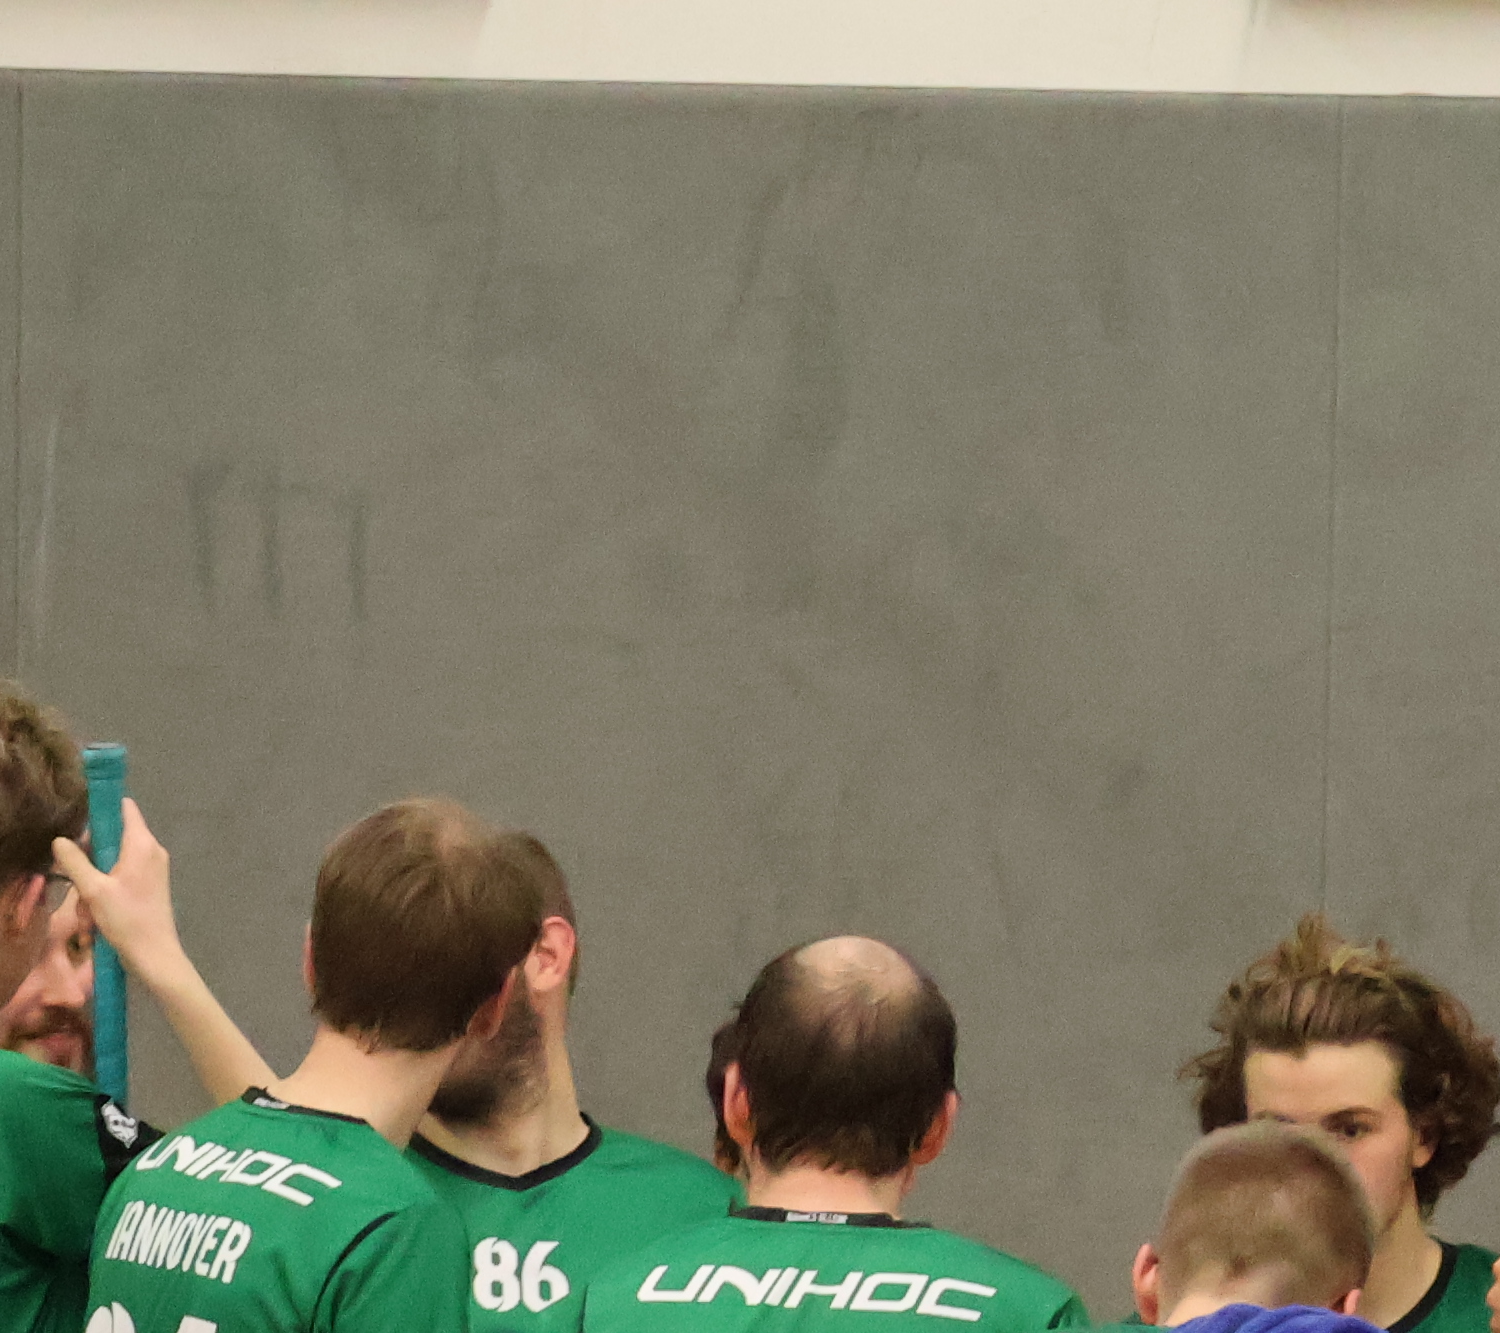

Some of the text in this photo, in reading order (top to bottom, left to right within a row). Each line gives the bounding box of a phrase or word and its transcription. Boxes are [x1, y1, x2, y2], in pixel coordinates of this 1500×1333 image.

[132, 1131, 344, 1208] UNIHOC
[471, 1235, 571, 1314] 86
[635, 1263, 998, 1323] UNIHOC
